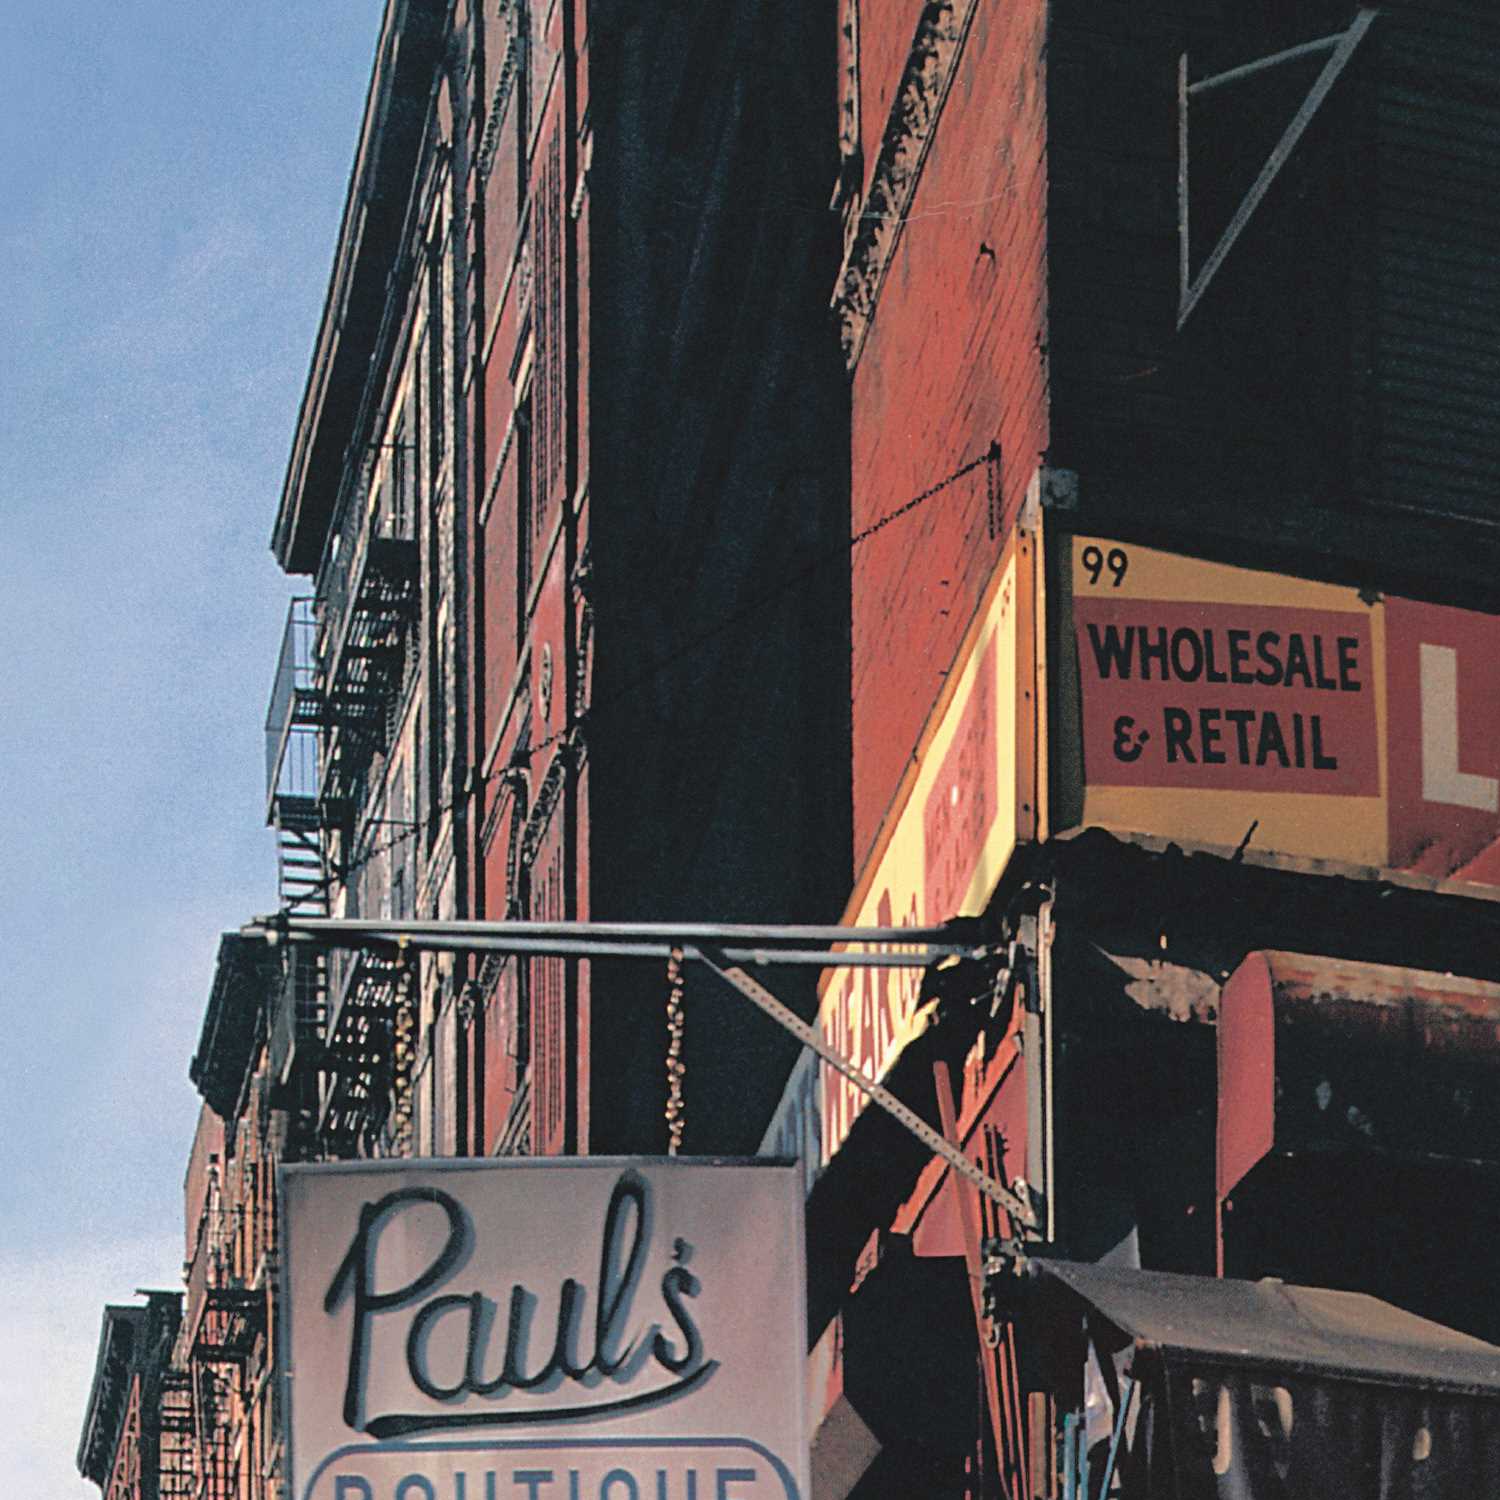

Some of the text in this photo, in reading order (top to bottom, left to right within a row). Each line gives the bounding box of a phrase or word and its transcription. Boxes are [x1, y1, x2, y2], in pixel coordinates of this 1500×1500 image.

[1081, 545, 1129, 588] 99
[1086, 623, 1361, 692] WHOLESALE
[1113, 706, 1338, 771] & RETAIL
[322, 1167, 721, 1440] Paul's
